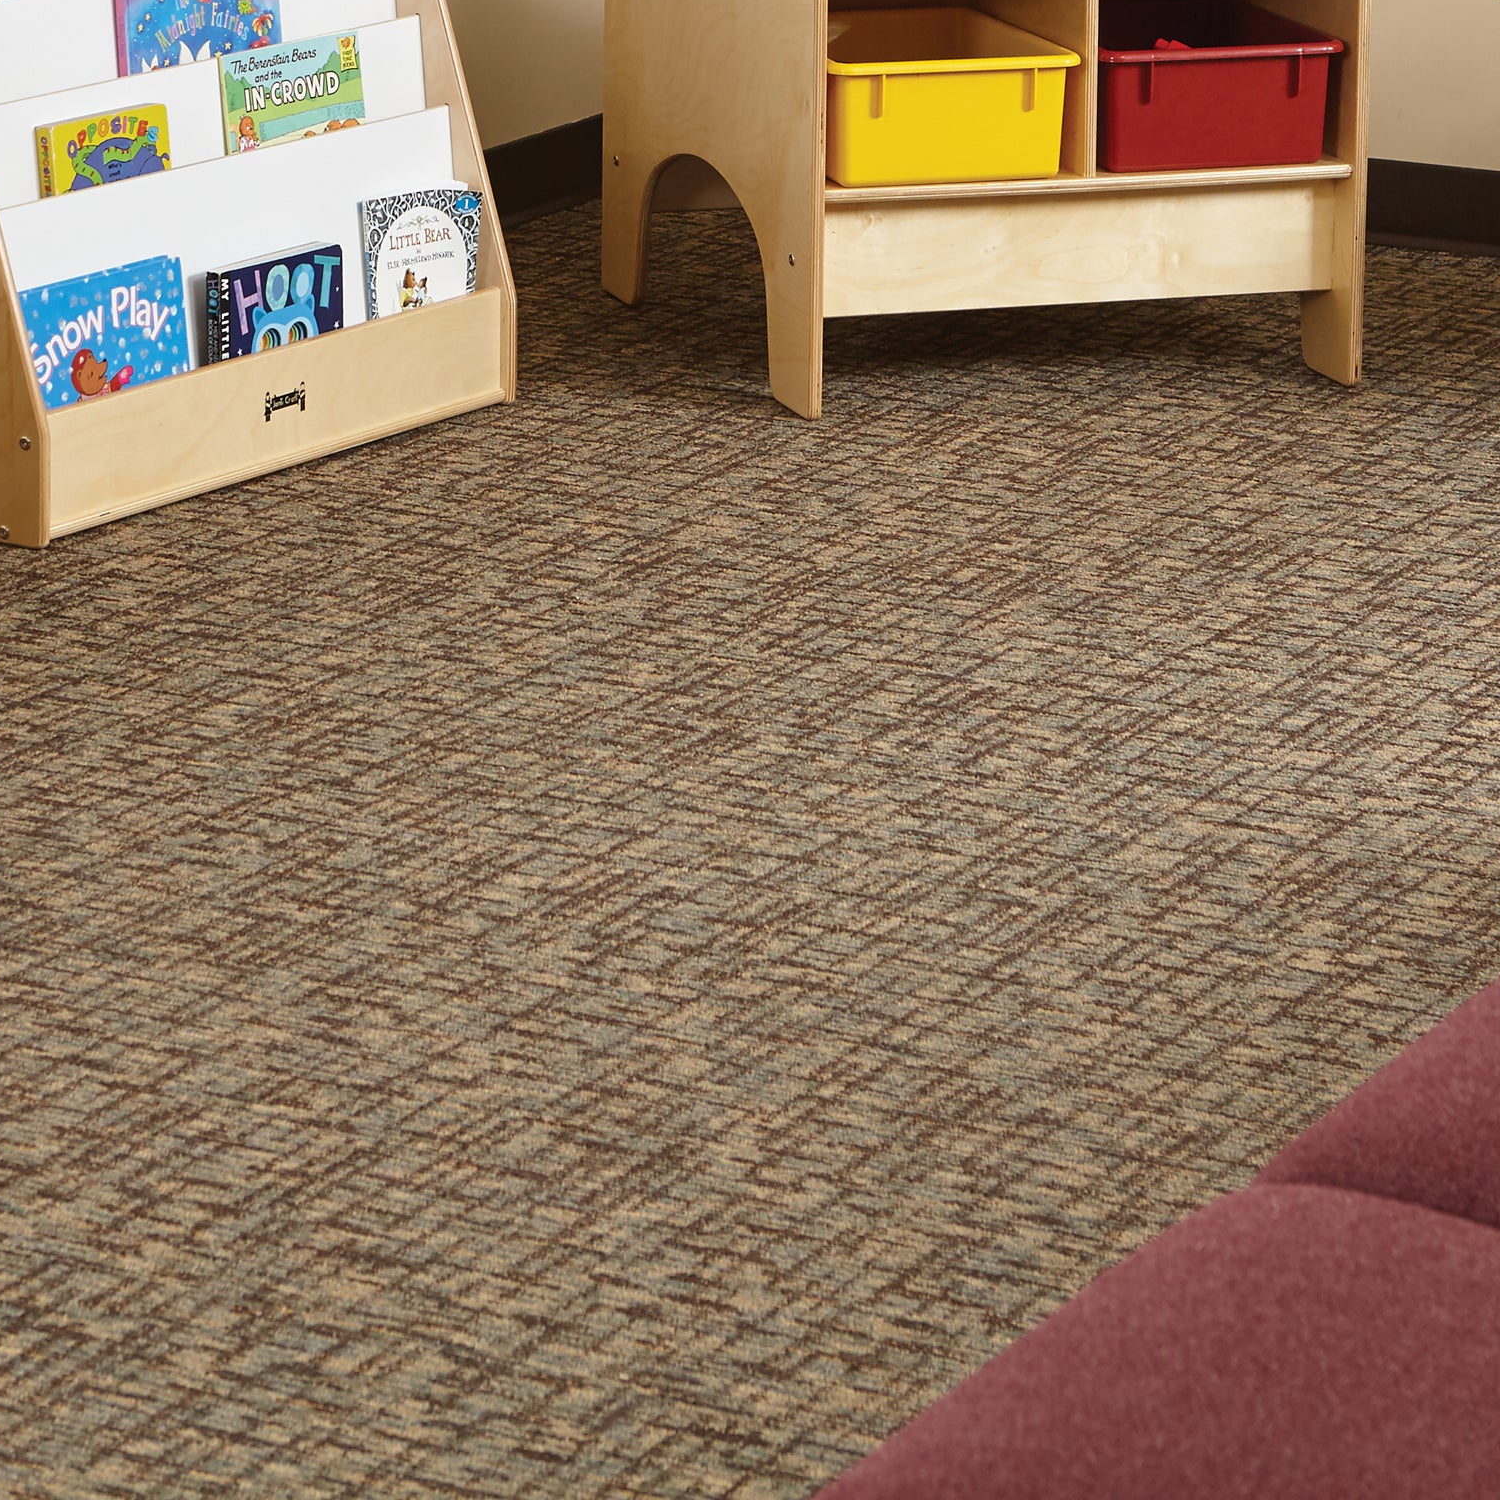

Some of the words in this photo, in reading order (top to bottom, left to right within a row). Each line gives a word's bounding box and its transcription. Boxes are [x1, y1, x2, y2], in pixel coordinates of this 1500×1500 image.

[155, 3, 205, 53] Midnight
[211, 2, 249, 41] Fairies
[231, 60, 247, 74] The
[248, 54, 290, 71] Berenstain
[291, 48, 317, 62] Bears
[254, 71, 269, 83] and
[270, 69, 282, 79] the
[244, 70, 341, 112] IN-CROWD
[67, 116, 159, 159] OPPOSITES
[464, 199, 470, 210] 1
[389, 233, 421, 250] LITTLE
[424, 228, 452, 244] BEAR
[207, 280, 219, 316] HOOT
[221, 279, 229, 300] MY
[233, 254, 341, 336] HOOT
[30, 305, 104, 384] Snow
[111, 285, 170, 341] Play
[221, 312, 230, 360] LITTLE
